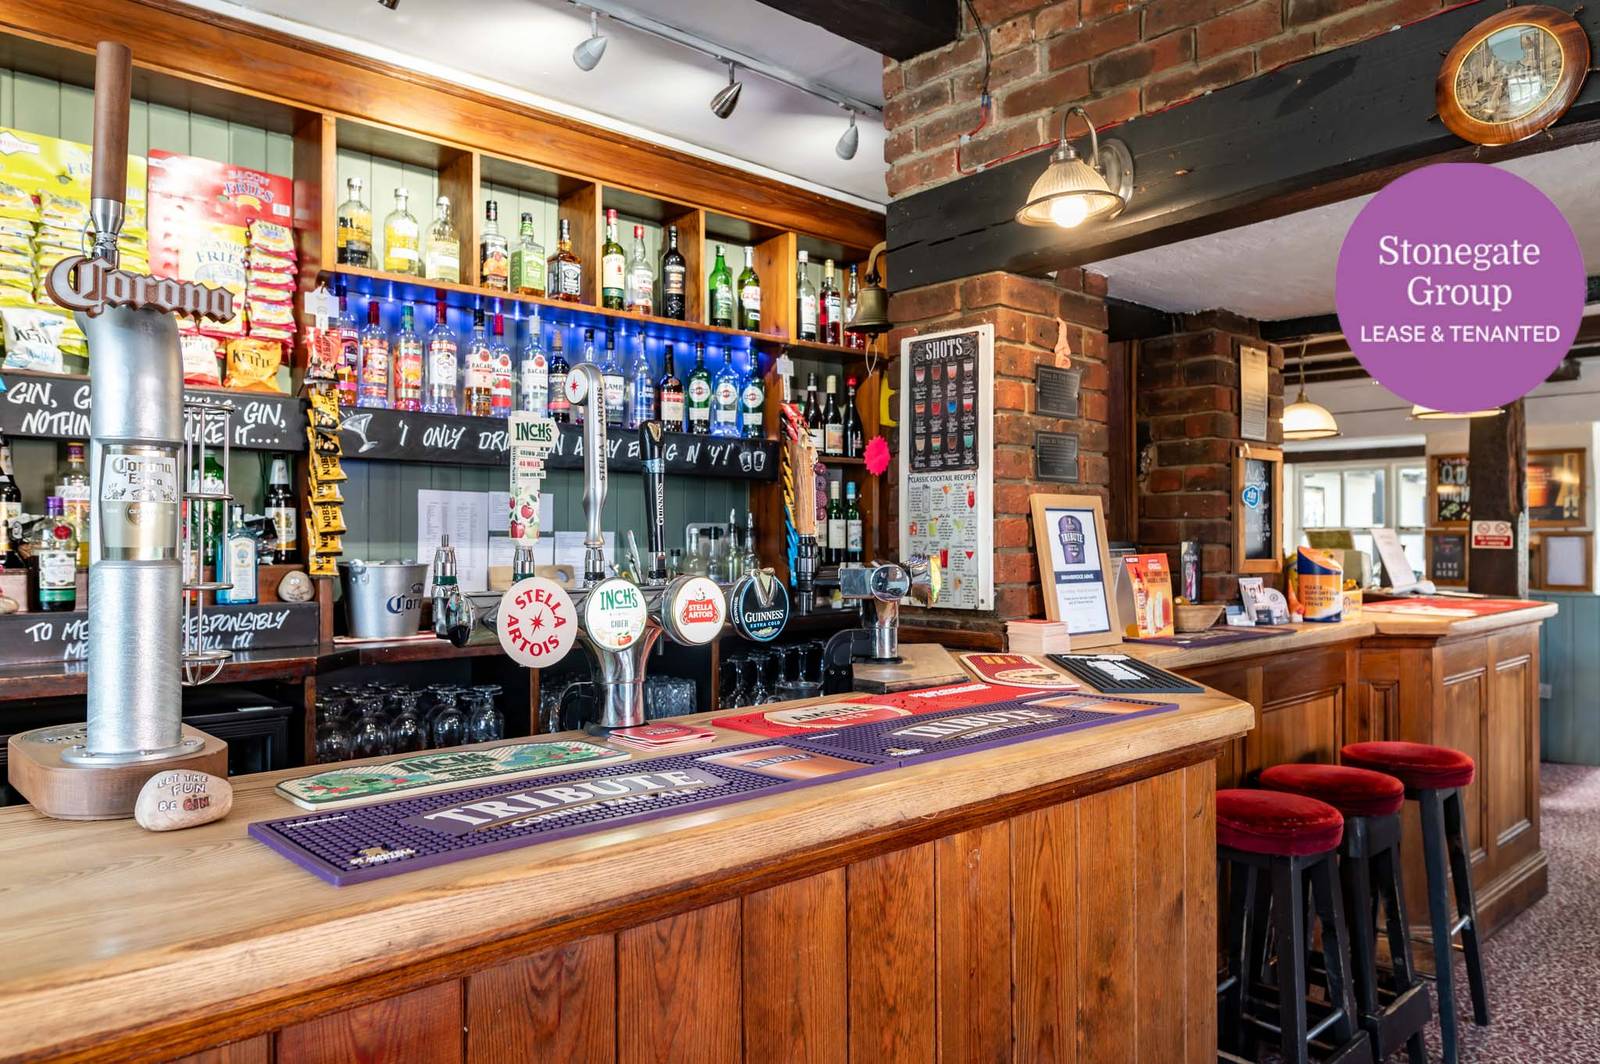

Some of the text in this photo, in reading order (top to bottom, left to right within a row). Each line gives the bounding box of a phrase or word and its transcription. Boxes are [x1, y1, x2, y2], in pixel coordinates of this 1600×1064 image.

[224, 181, 275, 204] FRIES
[45, 255, 236, 320] Corona
[925, 337, 963, 361] SHOTS
[7, 382, 58, 408] GIN,
[20, 409, 91, 436] NOTHIN
[244, 401, 286, 429] GIN,
[423, 424, 467, 450] ONLY
[479, 431, 510, 452] DRI
[596, 387, 607, 482] STELLA ARTOIS
[910, 473, 976, 483] CLASSIC COCKTAIL RECIPES
[656, 482, 664, 527] GUINNESS
[1060, 532, 1084, 543] TRIBUTE
[515, 588, 568, 628] STELLA
[688, 602, 714, 612] STELLA
[688, 610, 714, 619] ARTOIS
[745, 609, 784, 622] GUINNESS
[25, 622, 53, 642] TO
[507, 613, 561, 657] ARTOIS
[892, 709, 1055, 739] TRIBUTE
[158, 773, 209, 789] LET THE
[171, 783, 206, 796] FUN
[158, 796, 210, 812] BE GIN
[423, 771, 705, 826] TRIBUTE
